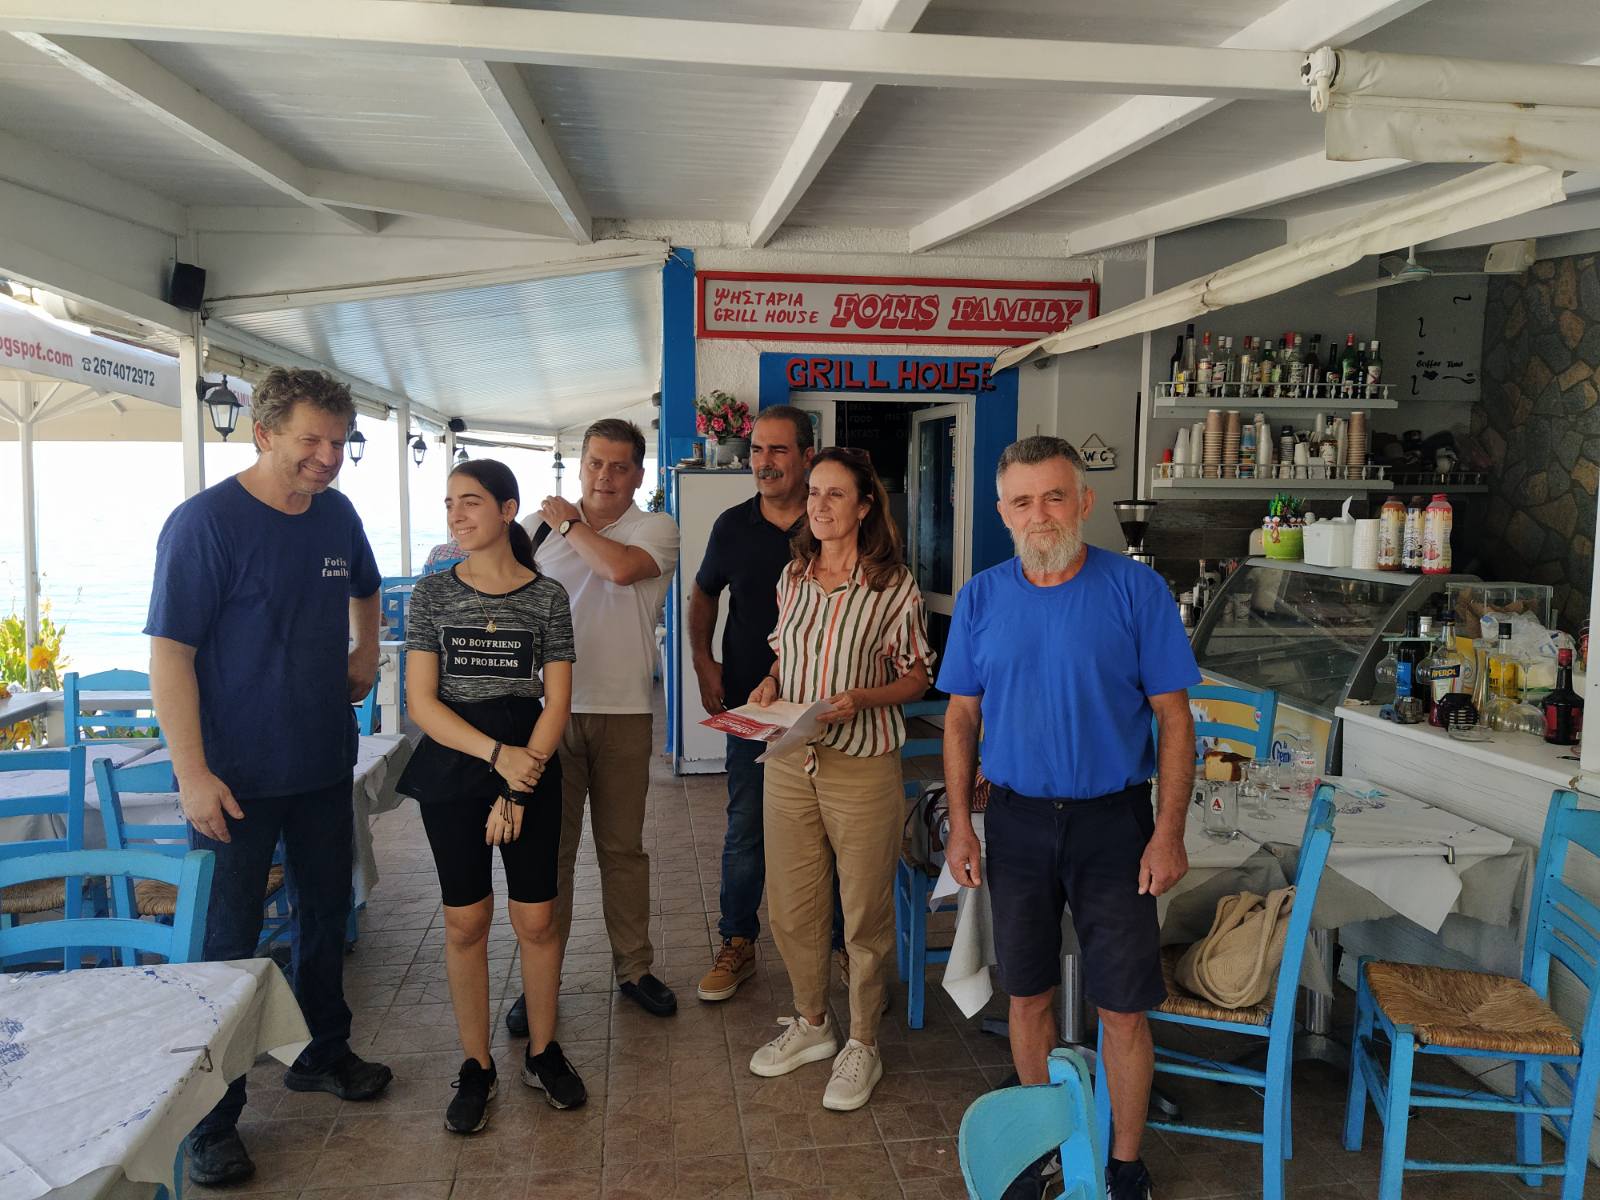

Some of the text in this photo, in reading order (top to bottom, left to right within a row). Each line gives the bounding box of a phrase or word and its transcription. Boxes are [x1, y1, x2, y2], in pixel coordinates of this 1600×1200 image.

[713, 307, 820, 324] GRILL HOUSE
[830, 293, 1083, 334] FOTIS FAMILY
[93, 356, 156, 387] 2674072972
[786, 358, 997, 392] GRILL HOUSE
[321, 567, 350, 579] family
[451, 637, 522, 649] NO BOYFRIEND
[454, 656, 519, 668] NO PROBLEMS
